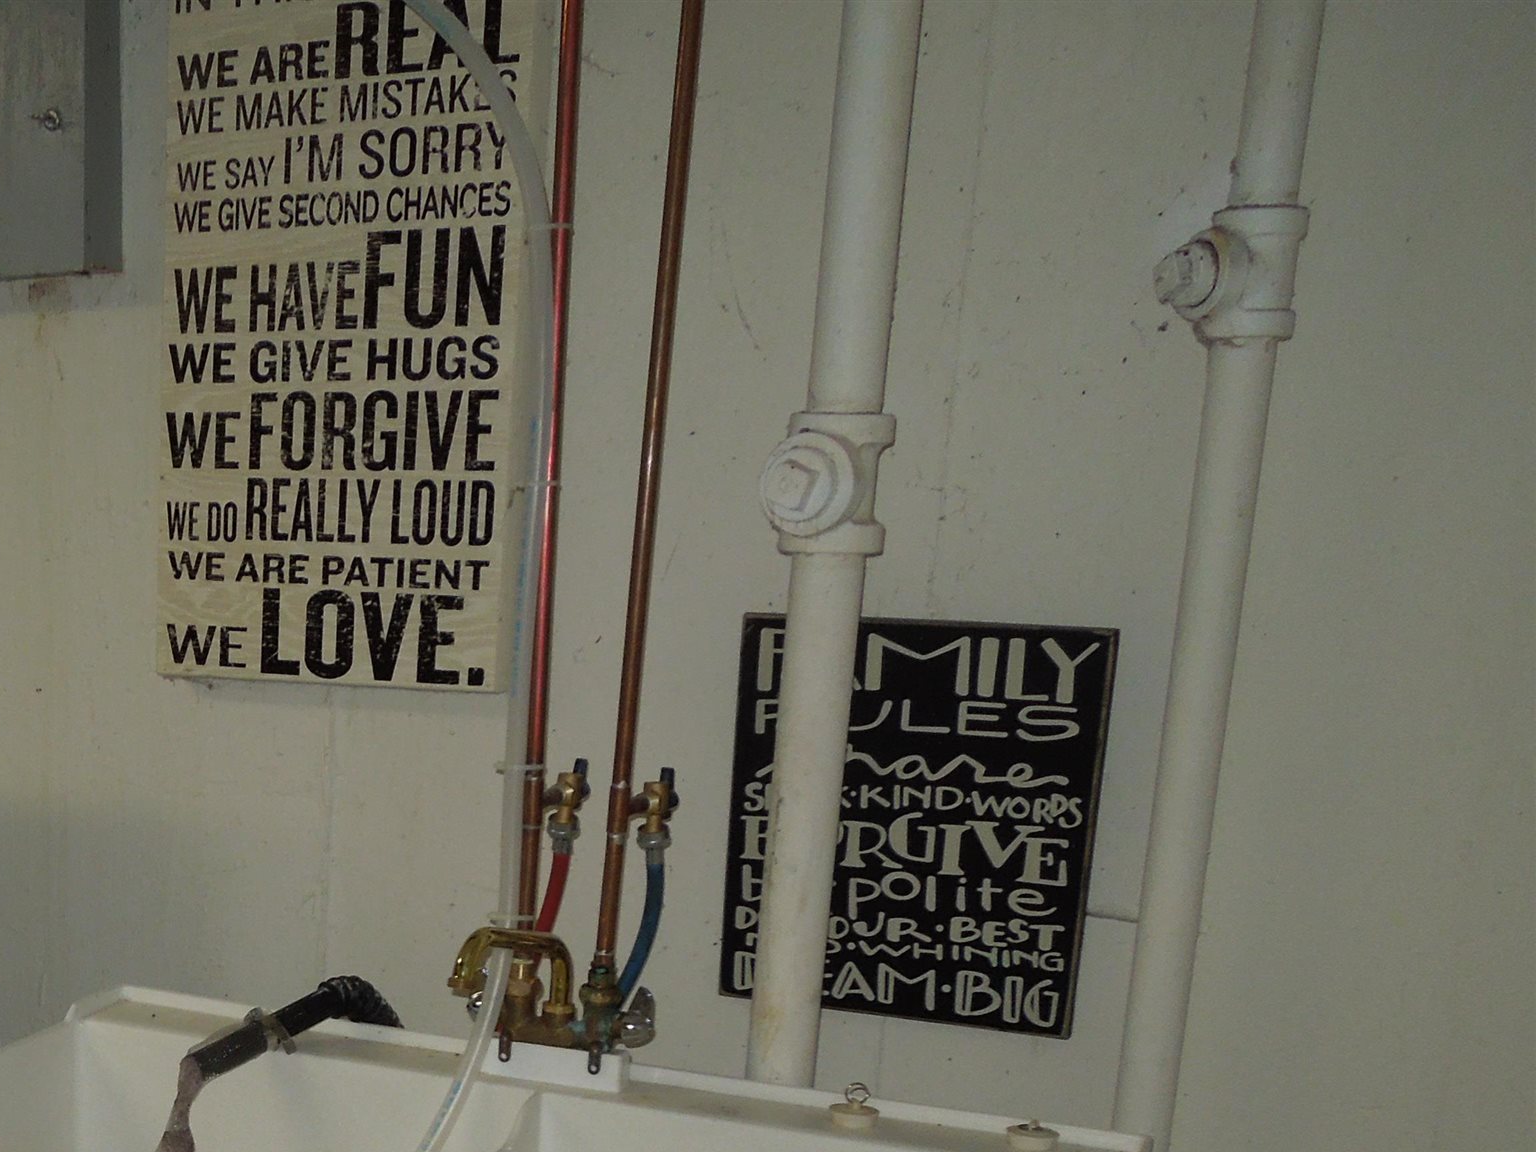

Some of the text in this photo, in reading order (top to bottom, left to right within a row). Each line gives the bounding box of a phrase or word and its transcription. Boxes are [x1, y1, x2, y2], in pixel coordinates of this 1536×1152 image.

[177, 50, 238, 90] WE
[250, 40, 330, 85] ARE
[177, 96, 224, 135] WE
[235, 87, 328, 131] MAKE
[177, 121, 507, 192] WE SAY I'M SORRY
[173, 181, 511, 234] WE GIVE SECOND CHANCES
[174, 224, 506, 334] WE HAVE FUN
[168, 335, 500, 384] WE GIVE HUGS
[166, 389, 500, 472] WE FORGIVE
[166, 477, 496, 547] WE DO REALLY LOUD
[168, 551, 490, 591] WE ARE PATIENT
[166, 587, 486, 686] WE LOVE.
[757, 627, 1100, 703] FMILY
[756, 744, 1069, 787] hare
[739, 812, 1069, 887] FRGIVE
[829, 912, 931, 942] OUR
[950, 916, 1064, 951] BEST
